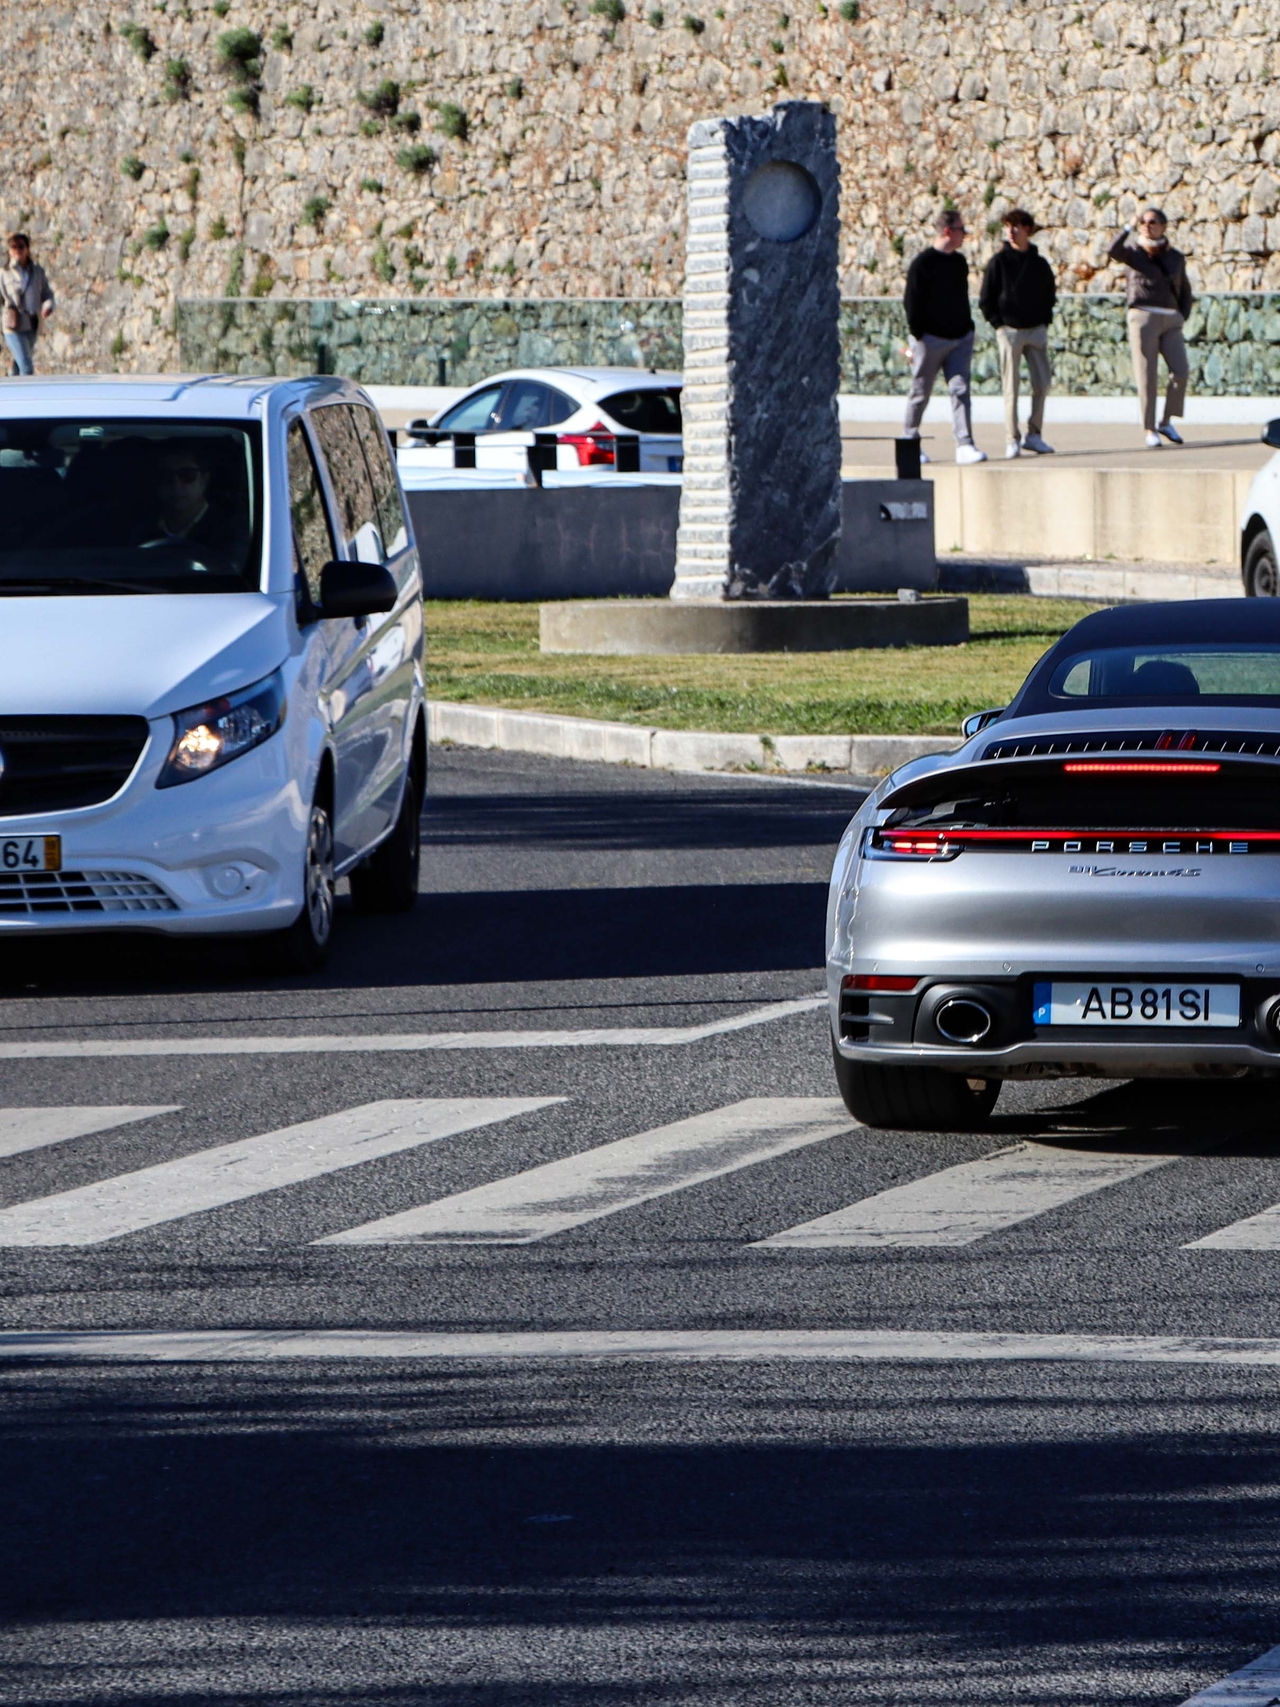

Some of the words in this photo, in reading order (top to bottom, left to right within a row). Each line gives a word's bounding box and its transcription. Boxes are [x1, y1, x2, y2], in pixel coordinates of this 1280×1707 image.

[2, 840, 40, 868] 64
[1031, 840, 1249, 854] PORSCHE
[1038, 1008, 1046, 1018] P
